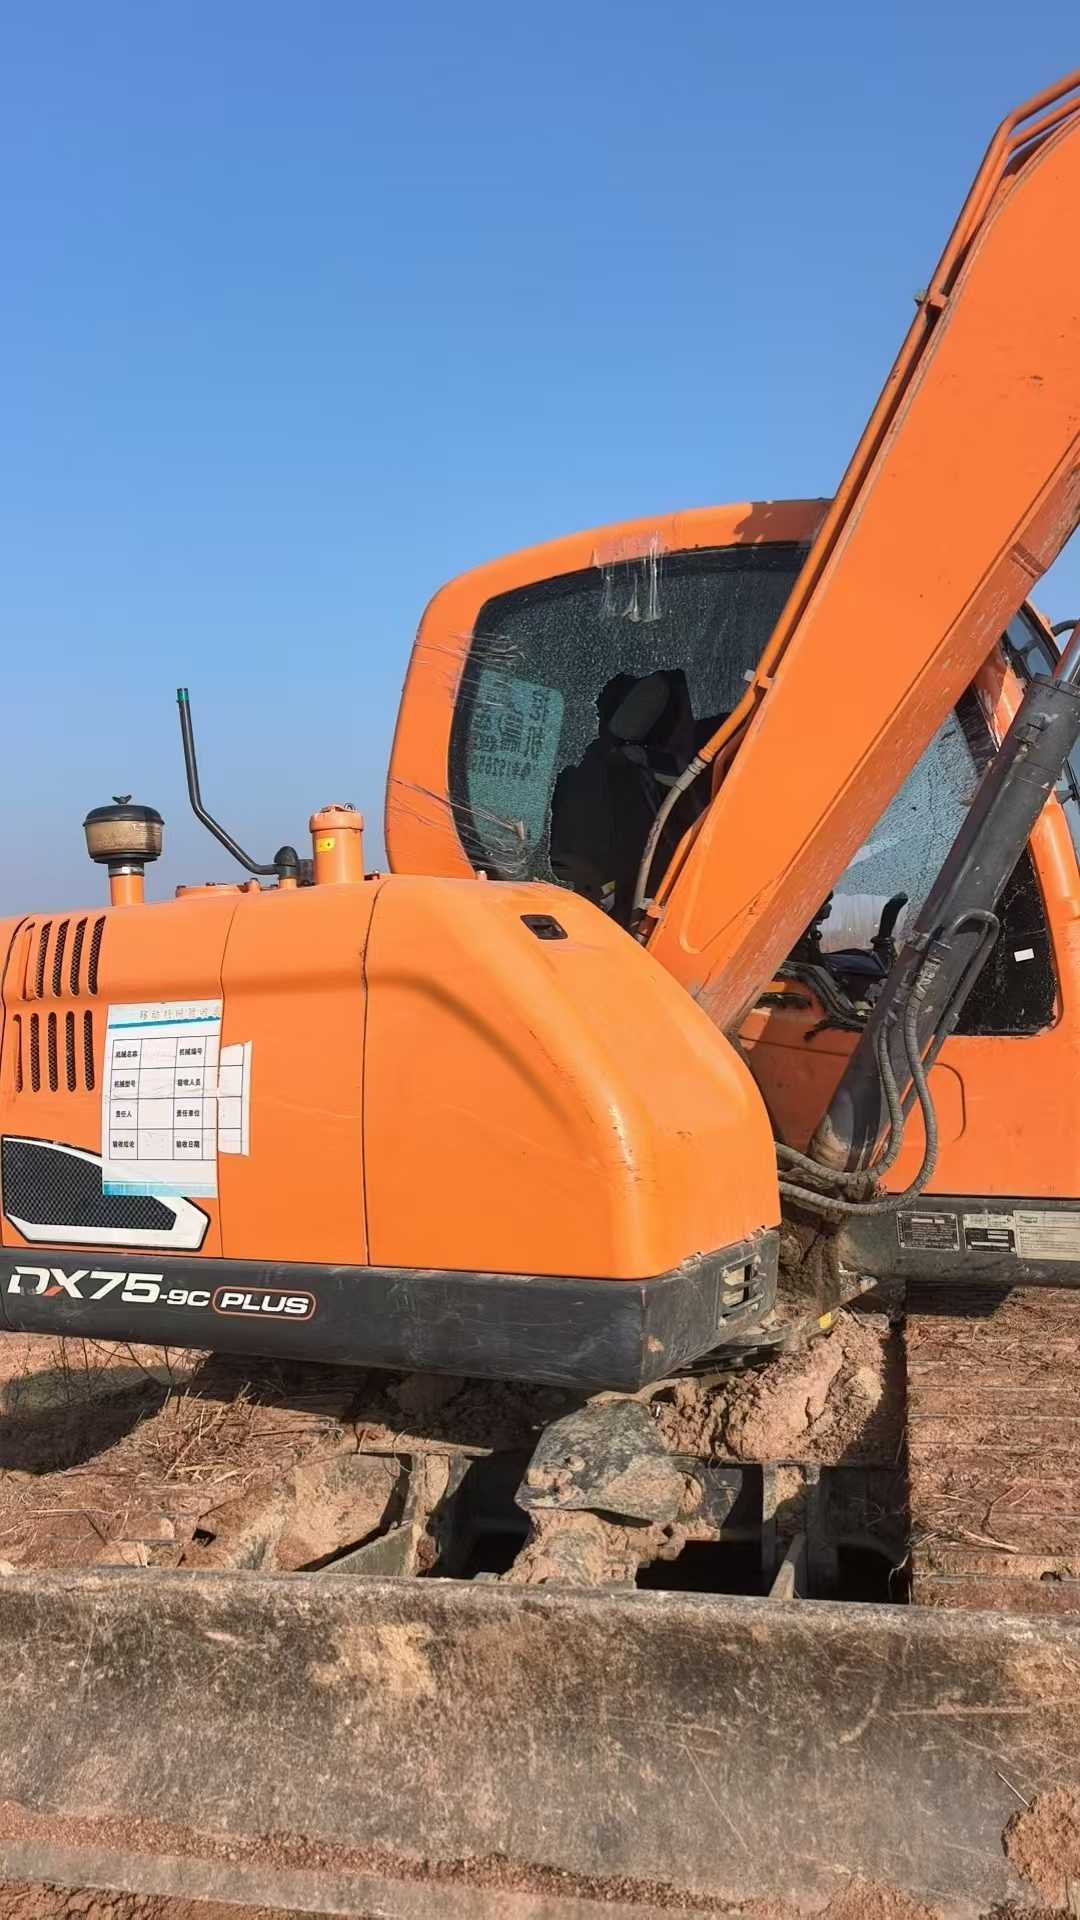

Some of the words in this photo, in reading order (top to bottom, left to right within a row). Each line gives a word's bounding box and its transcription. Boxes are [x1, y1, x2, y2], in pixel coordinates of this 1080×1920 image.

[115, 1050, 138, 1058] 机械名称
[179, 1047, 203, 1056] 机械编号
[114, 1080, 136, 1088] 机械型号
[177, 1079, 201, 1087] 验收人员
[115, 1110, 132, 1118] 责任人
[176, 1109, 200, 1118] 责任单位
[176, 1140, 200, 1149] 验收日期
[220, 1292, 310, 1314] PLUS
